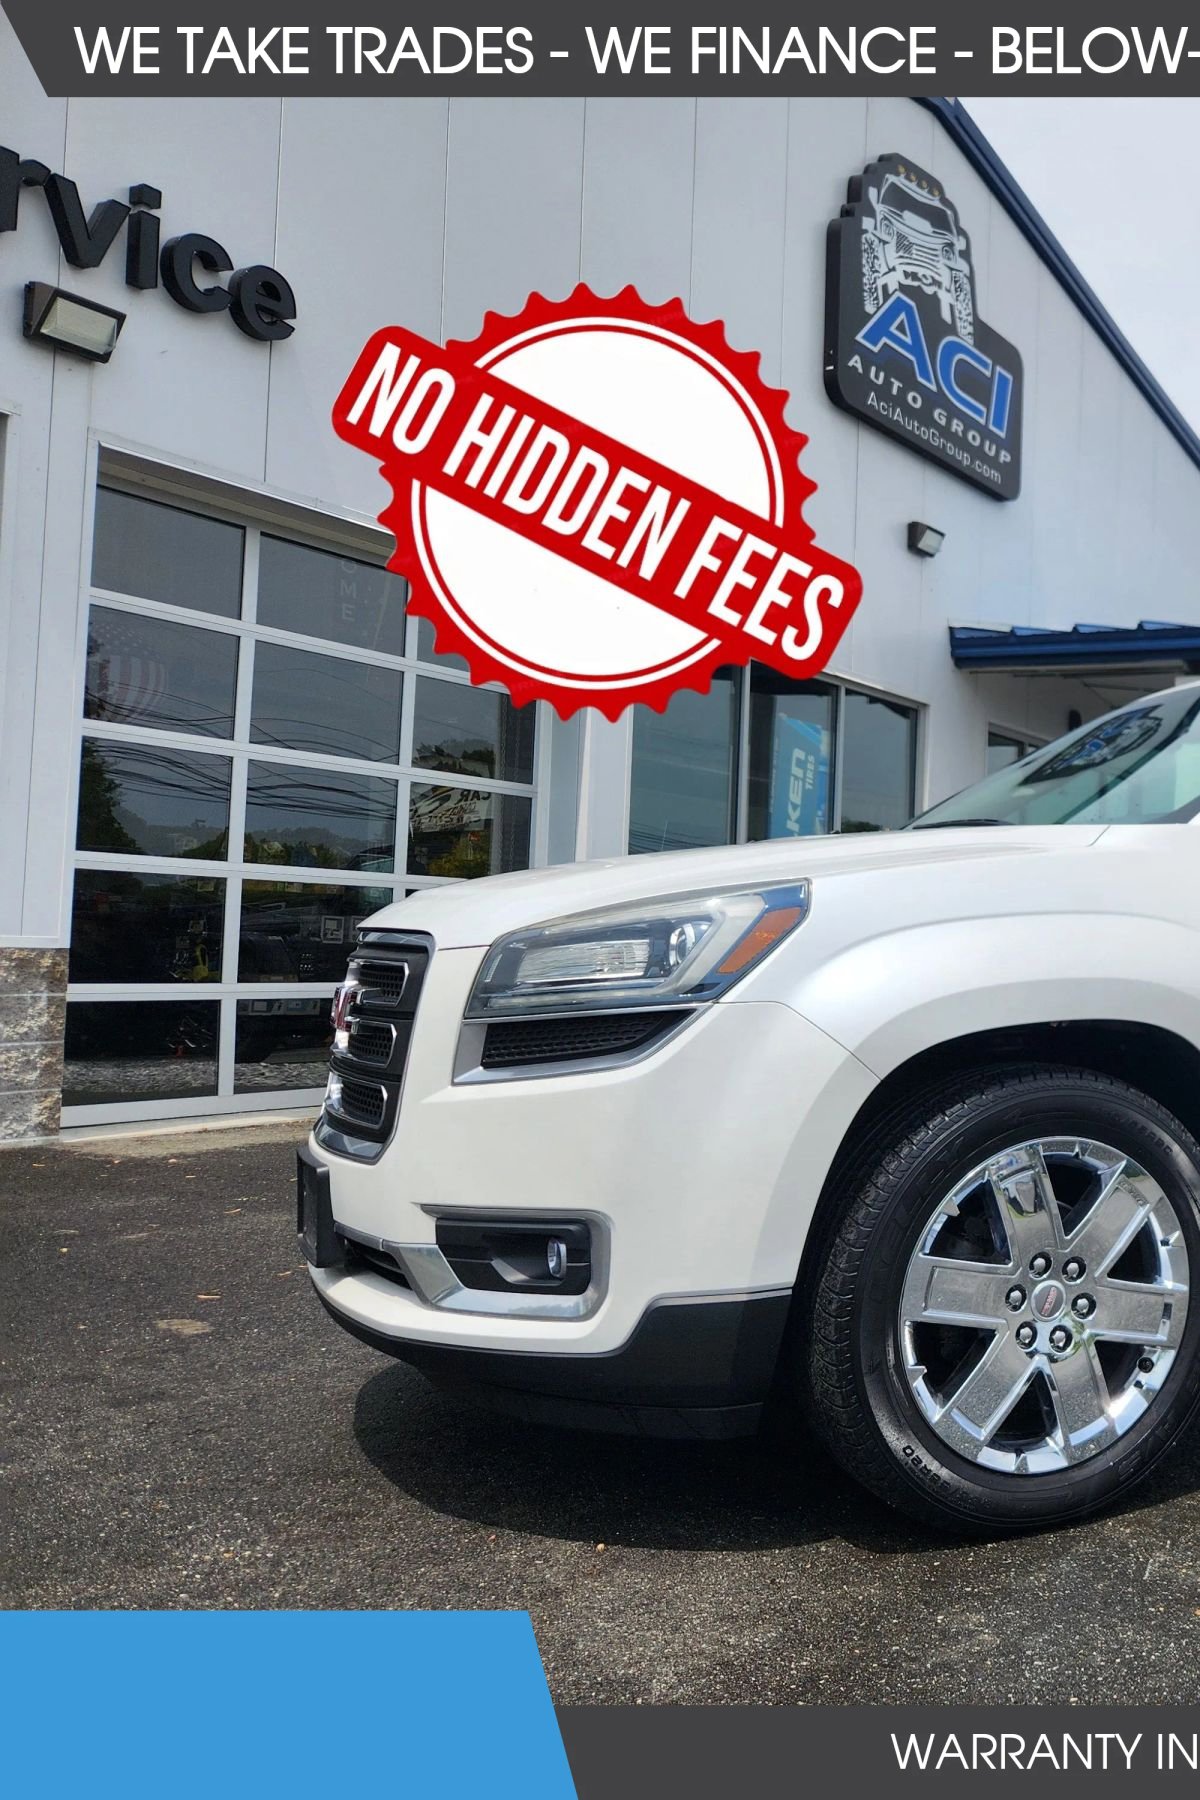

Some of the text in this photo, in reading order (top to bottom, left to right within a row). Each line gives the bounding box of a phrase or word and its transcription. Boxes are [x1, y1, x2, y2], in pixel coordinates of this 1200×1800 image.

[0, 145, 297, 341] rvice
[848, 354, 1012, 464] AUTO GROUP
[856, 290, 1013, 439] ACI
[867, 391, 1002, 484] AciAutoGroup.com
[805, 754, 815, 790] TIRES
